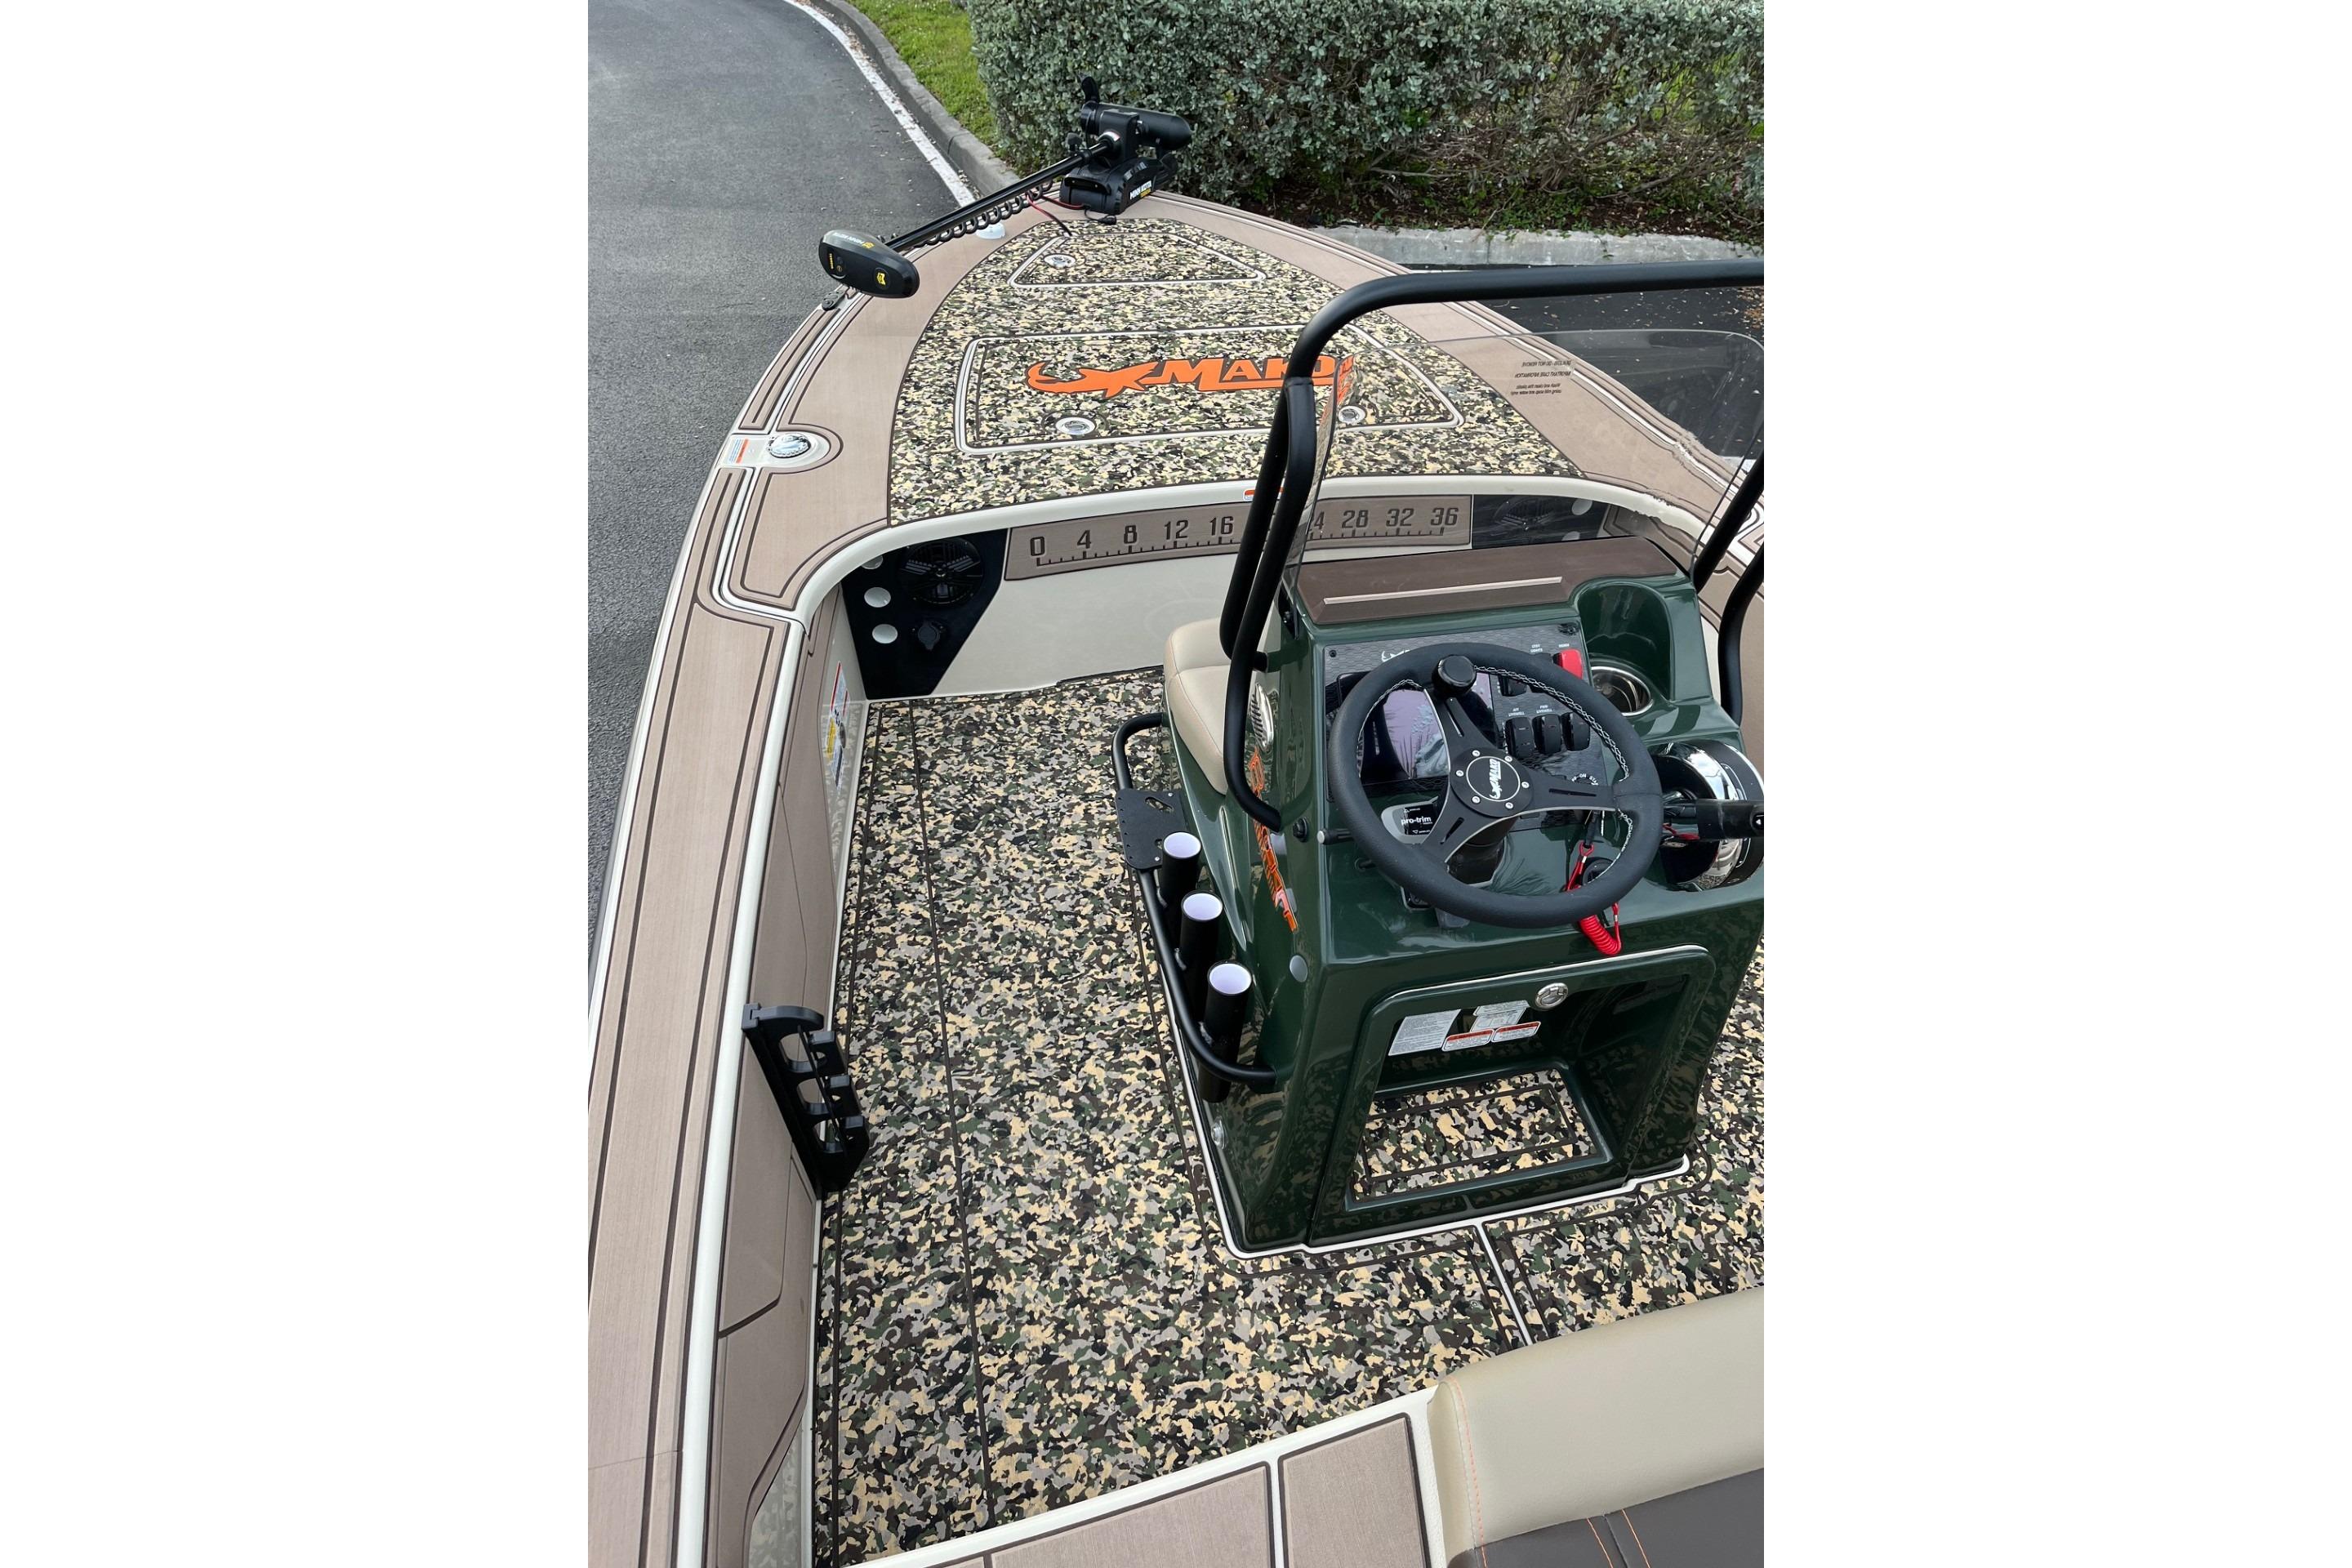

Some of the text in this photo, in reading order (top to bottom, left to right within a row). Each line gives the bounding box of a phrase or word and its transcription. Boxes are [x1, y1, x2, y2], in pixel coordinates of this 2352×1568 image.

[1076, 530, 1092, 549] 4
[1123, 524, 1138, 544] 8
[1165, 519, 1190, 541] 12
[1209, 515, 1234, 537] 16
[1341, 510, 1369, 528] 28
[1386, 508, 1414, 528] 32
[1430, 507, 1459, 526] 36
[1401, 817, 1432, 826] pro-trim
